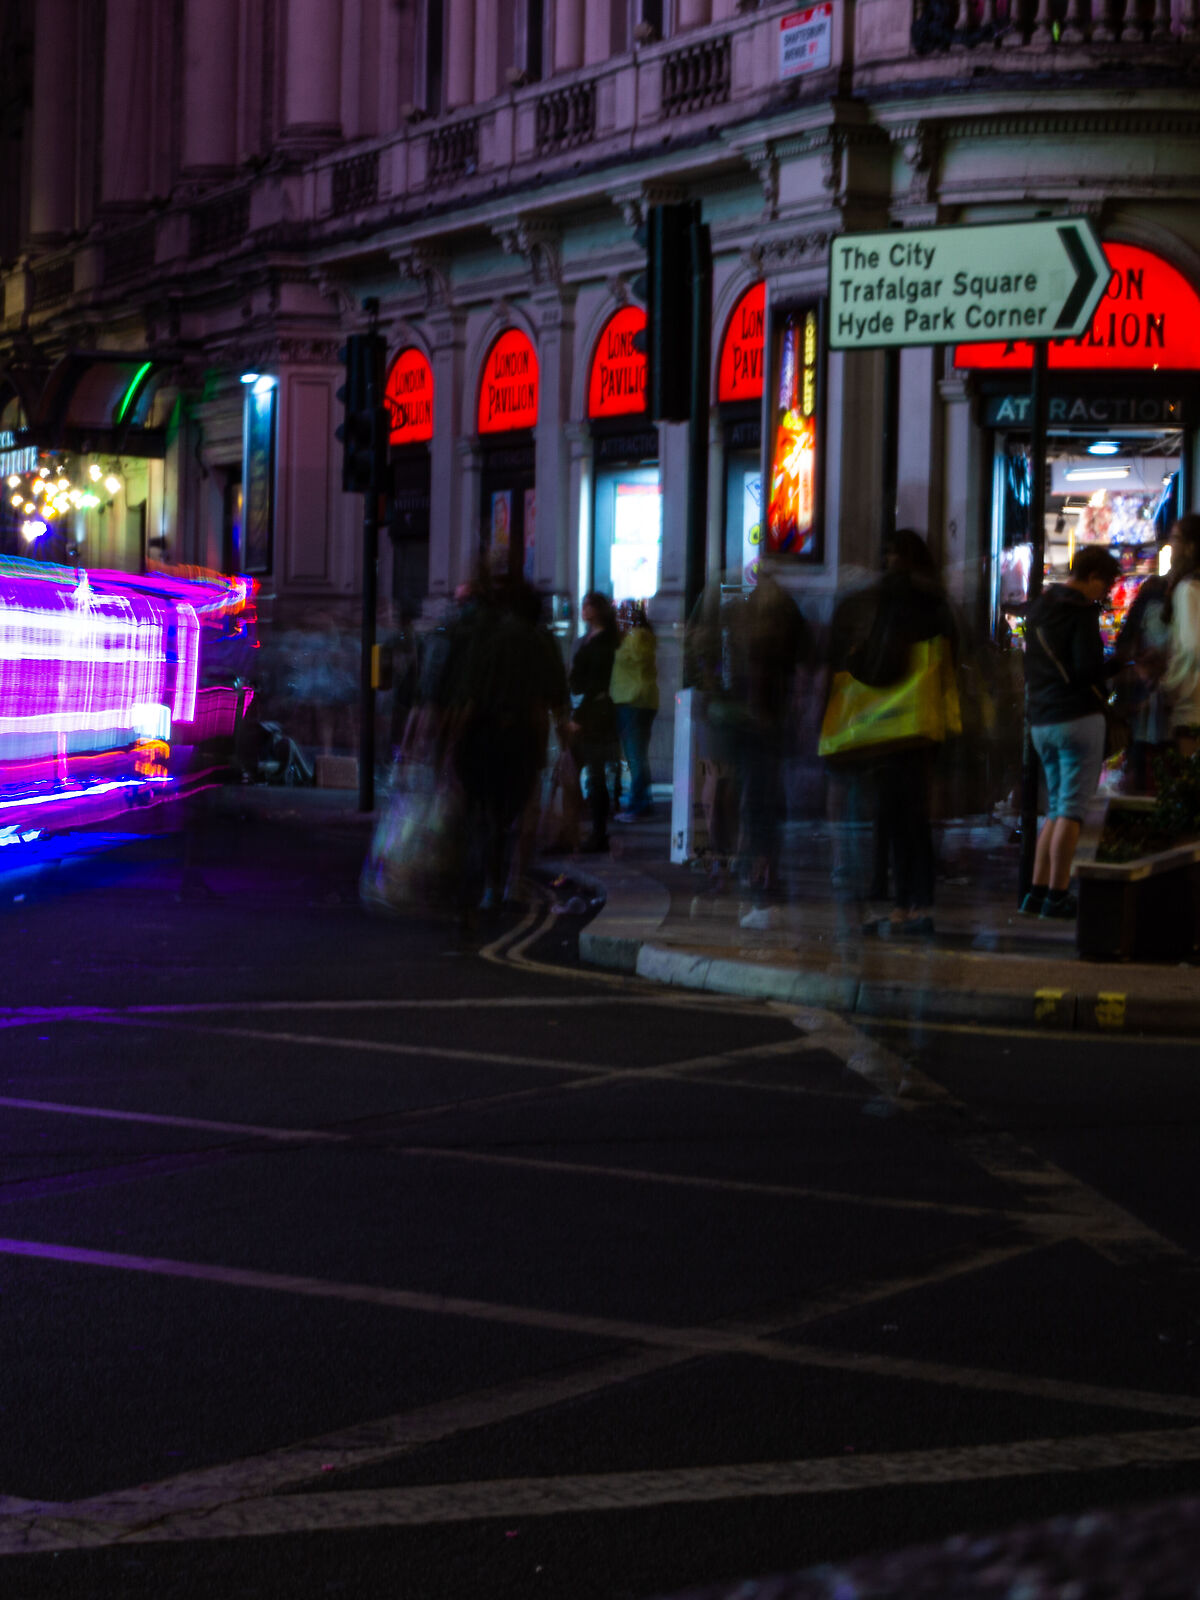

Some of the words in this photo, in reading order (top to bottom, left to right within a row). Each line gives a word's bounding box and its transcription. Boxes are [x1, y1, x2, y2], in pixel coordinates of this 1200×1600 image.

[841, 247, 879, 271] The
[889, 243, 936, 270] City
[840, 277, 942, 303] Trafalgar
[953, 271, 1038, 299] Square
[838, 311, 894, 340] Hyde
[904, 307, 956, 333] Park
[965, 305, 1047, 329] Corner
[495, 350, 529, 380] LONDON
[488, 382, 535, 422] PAVILION
[996, 396, 1182, 421] ATRACTION
